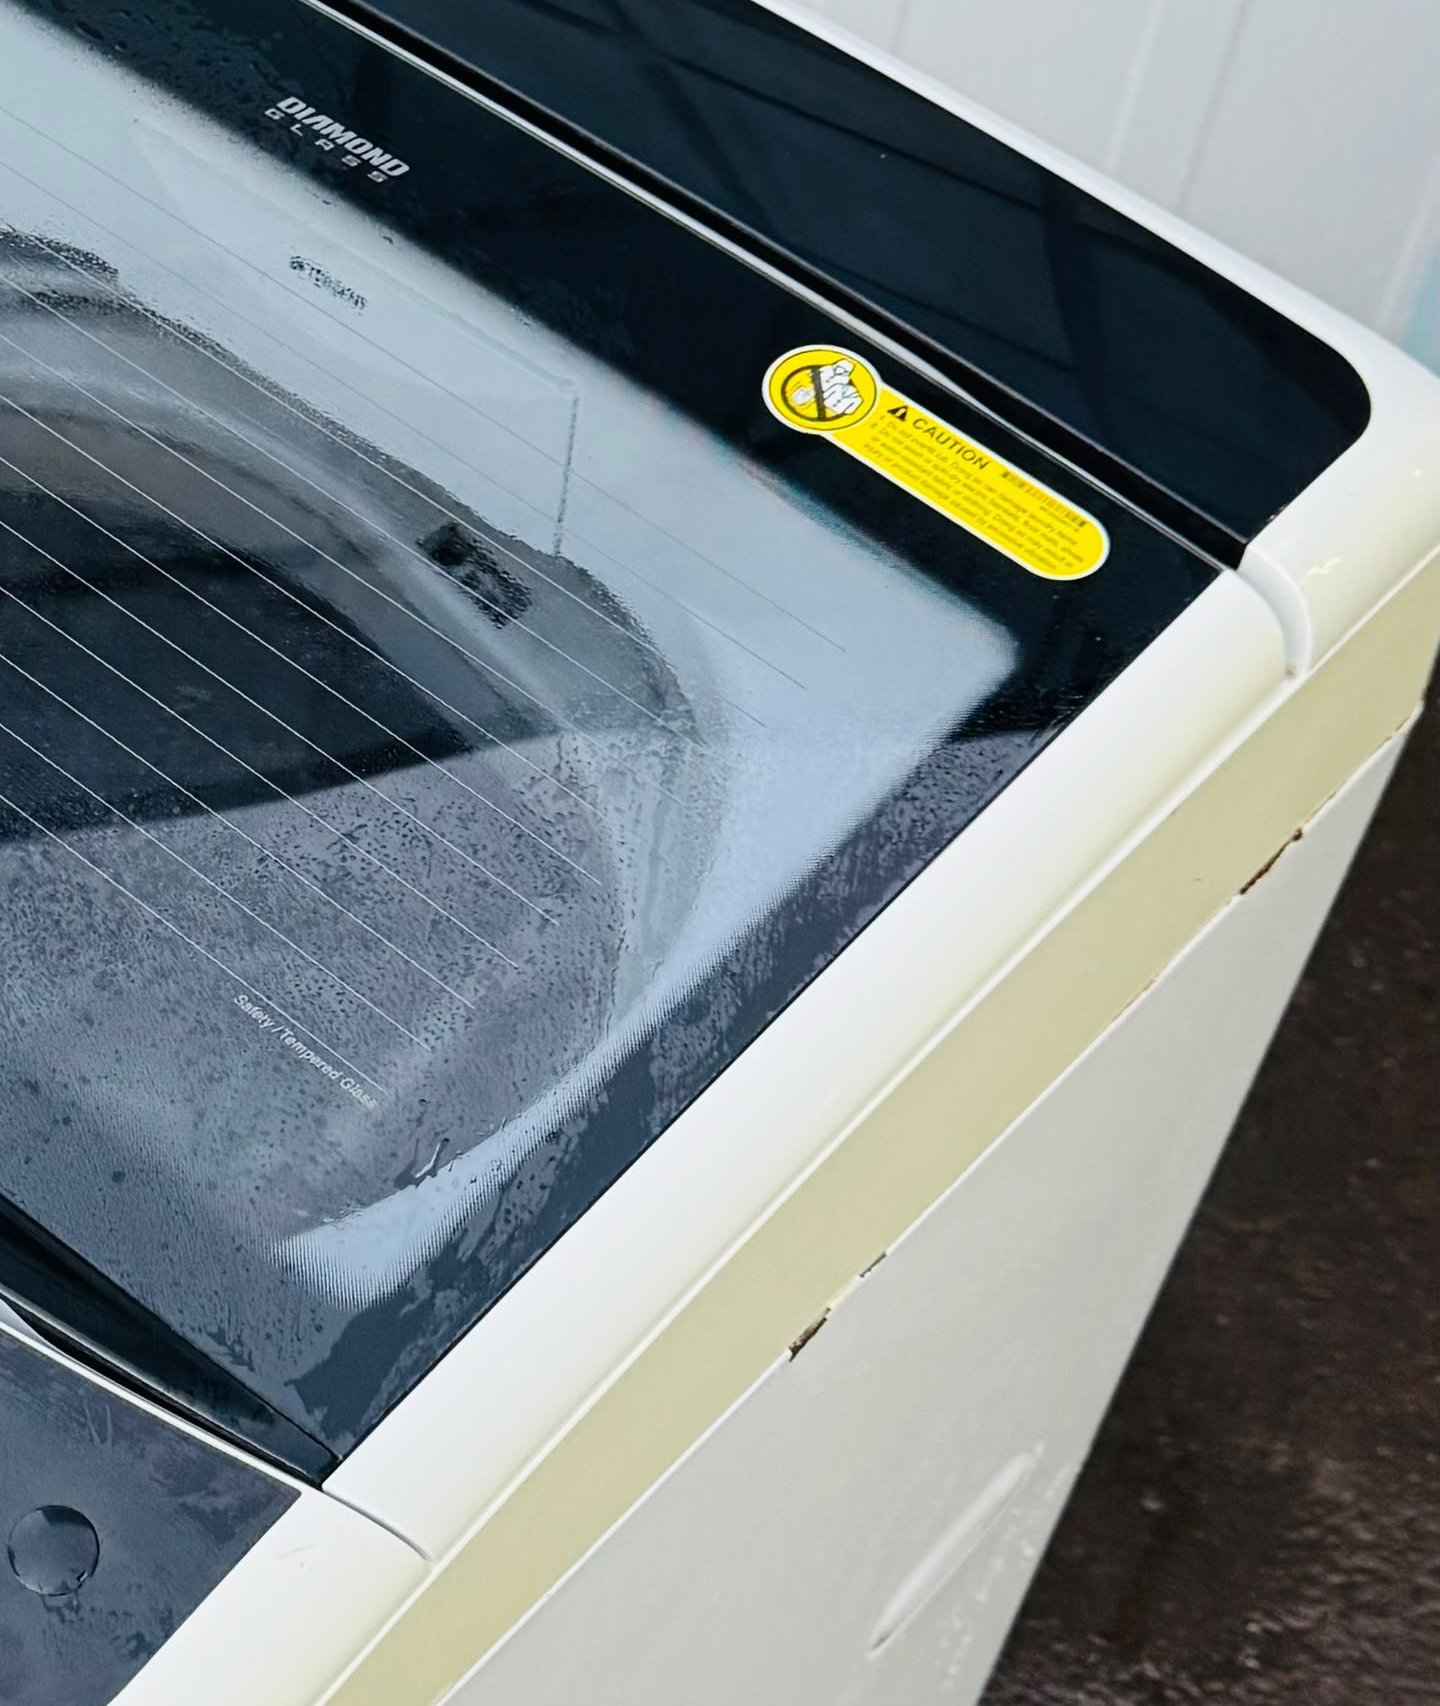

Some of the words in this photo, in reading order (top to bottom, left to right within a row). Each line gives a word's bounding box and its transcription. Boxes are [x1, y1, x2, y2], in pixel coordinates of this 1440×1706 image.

[264, 107, 389, 183] GLASS
[275, 96, 410, 177] DIAMOND
[912, 417, 991, 470] CAUTION
[233, 994, 275, 1028] Safety
